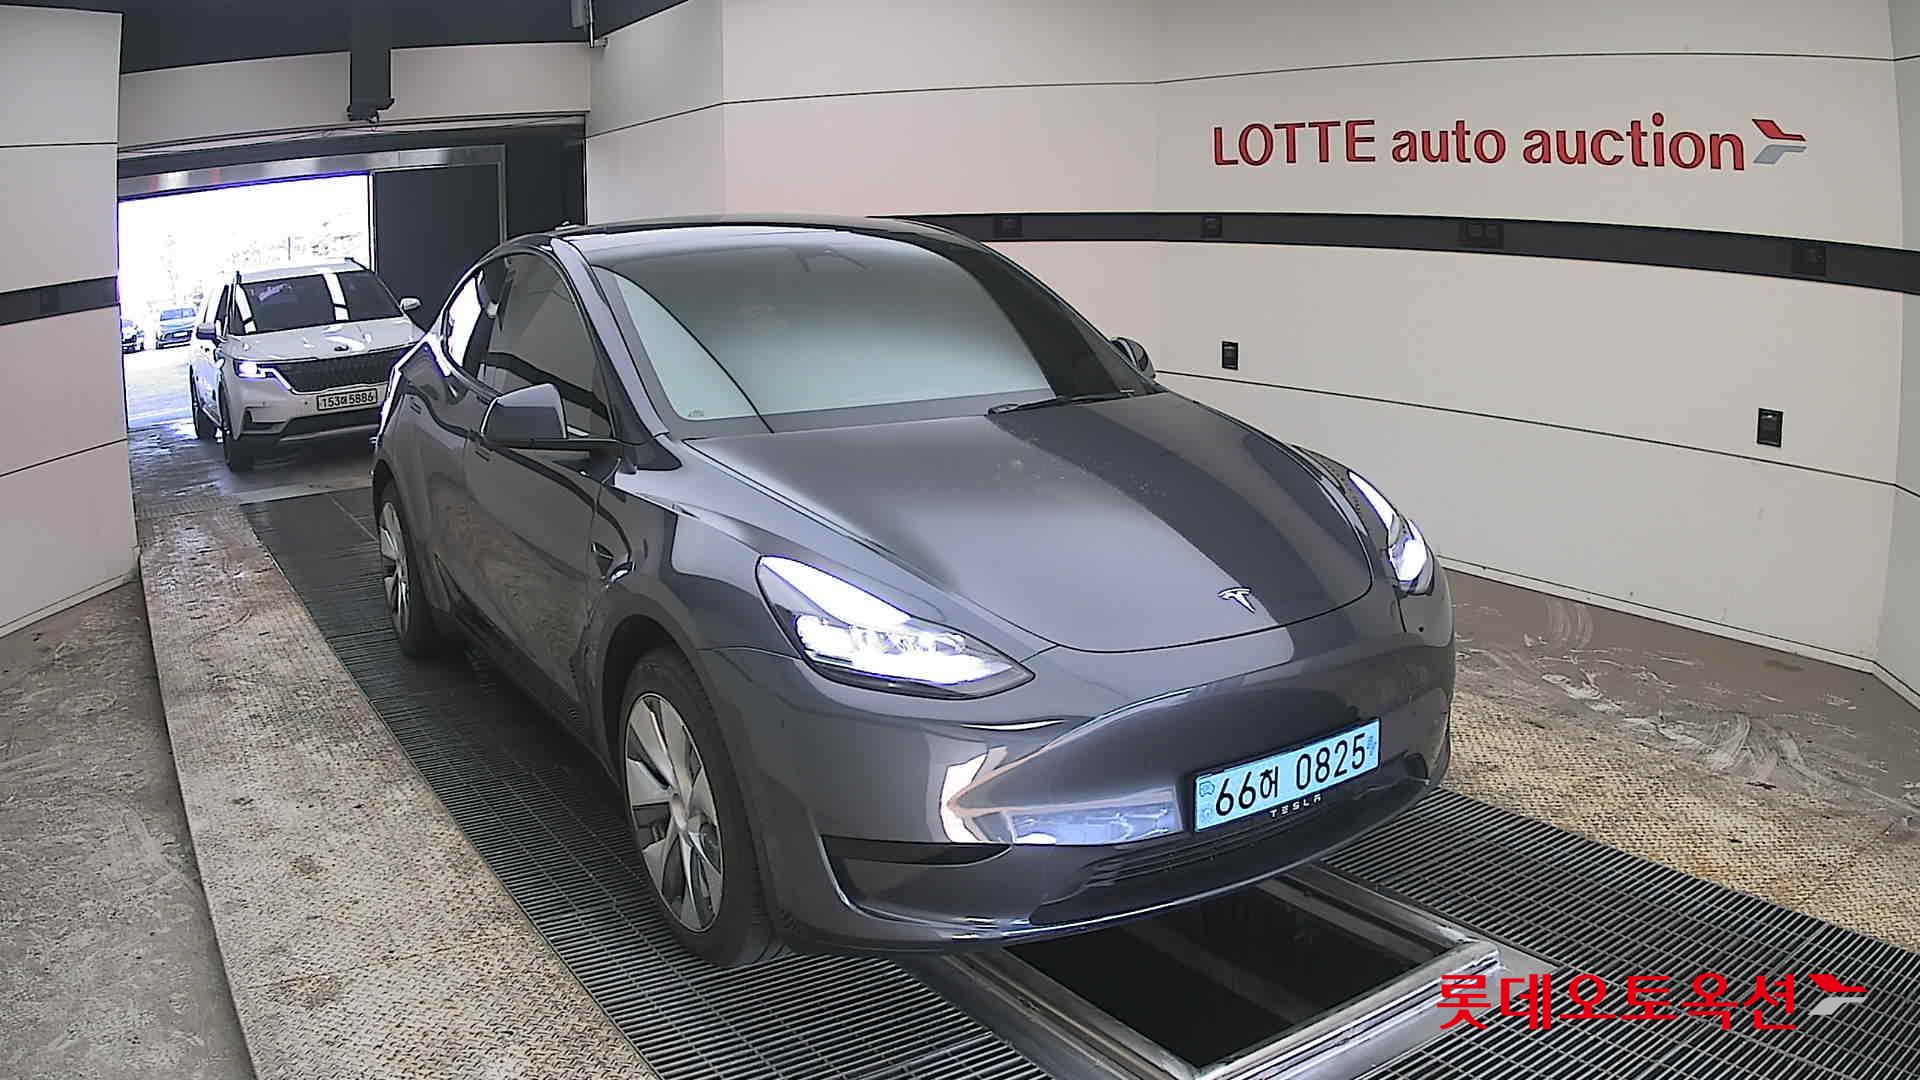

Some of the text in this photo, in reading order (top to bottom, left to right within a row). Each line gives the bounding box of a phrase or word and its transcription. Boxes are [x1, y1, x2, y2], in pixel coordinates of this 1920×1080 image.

[1214, 112, 1744, 171] LOTTE auto auction
[1215, 732, 1366, 816] 66허 0825
[1269, 794, 1322, 818] TESLA
